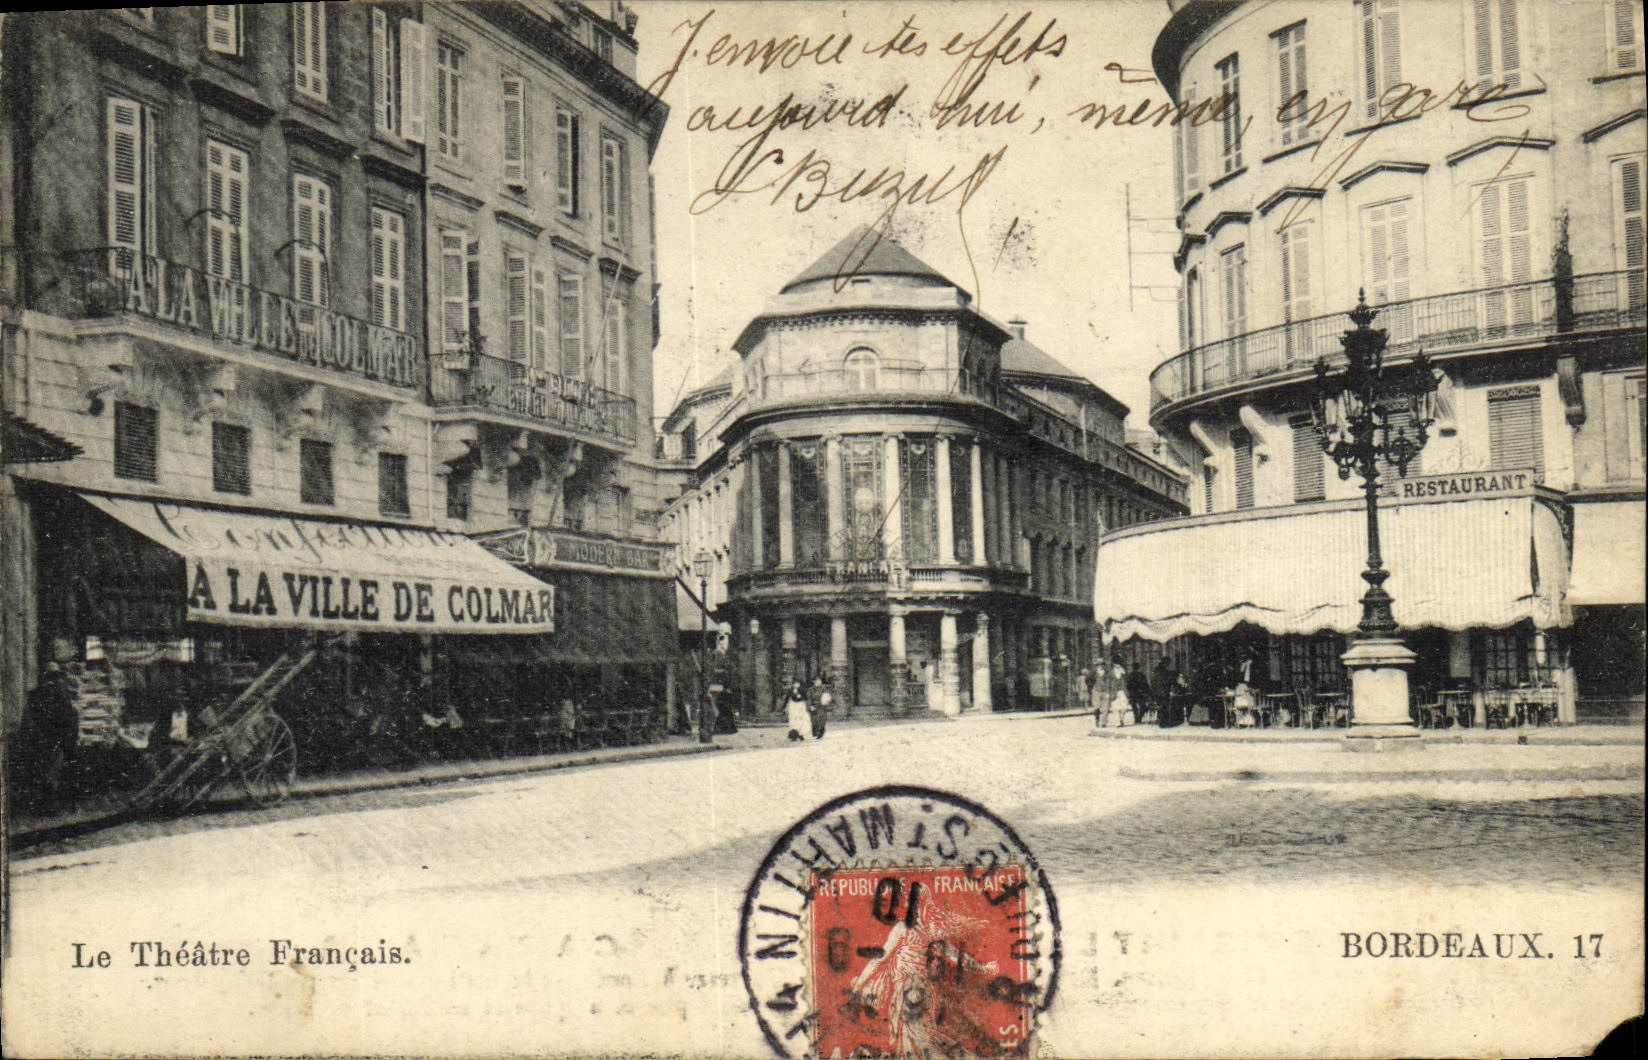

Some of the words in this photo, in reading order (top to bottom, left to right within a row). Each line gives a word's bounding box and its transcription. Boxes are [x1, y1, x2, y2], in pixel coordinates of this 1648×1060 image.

[863, 14, 929, 58] tes
[157, 259, 199, 328] LA
[206, 274, 297, 354] VILLE
[320, 309, 417, 386] COLMAR
[1403, 474, 1527, 498] RESTAURANT
[627, 549, 649, 568] BAR
[187, 564, 217, 611] A
[226, 568, 278, 617] LA
[283, 573, 379, 622] VILLE
[393, 582, 435, 623] DE
[447, 584, 554, 625] COLMAR
